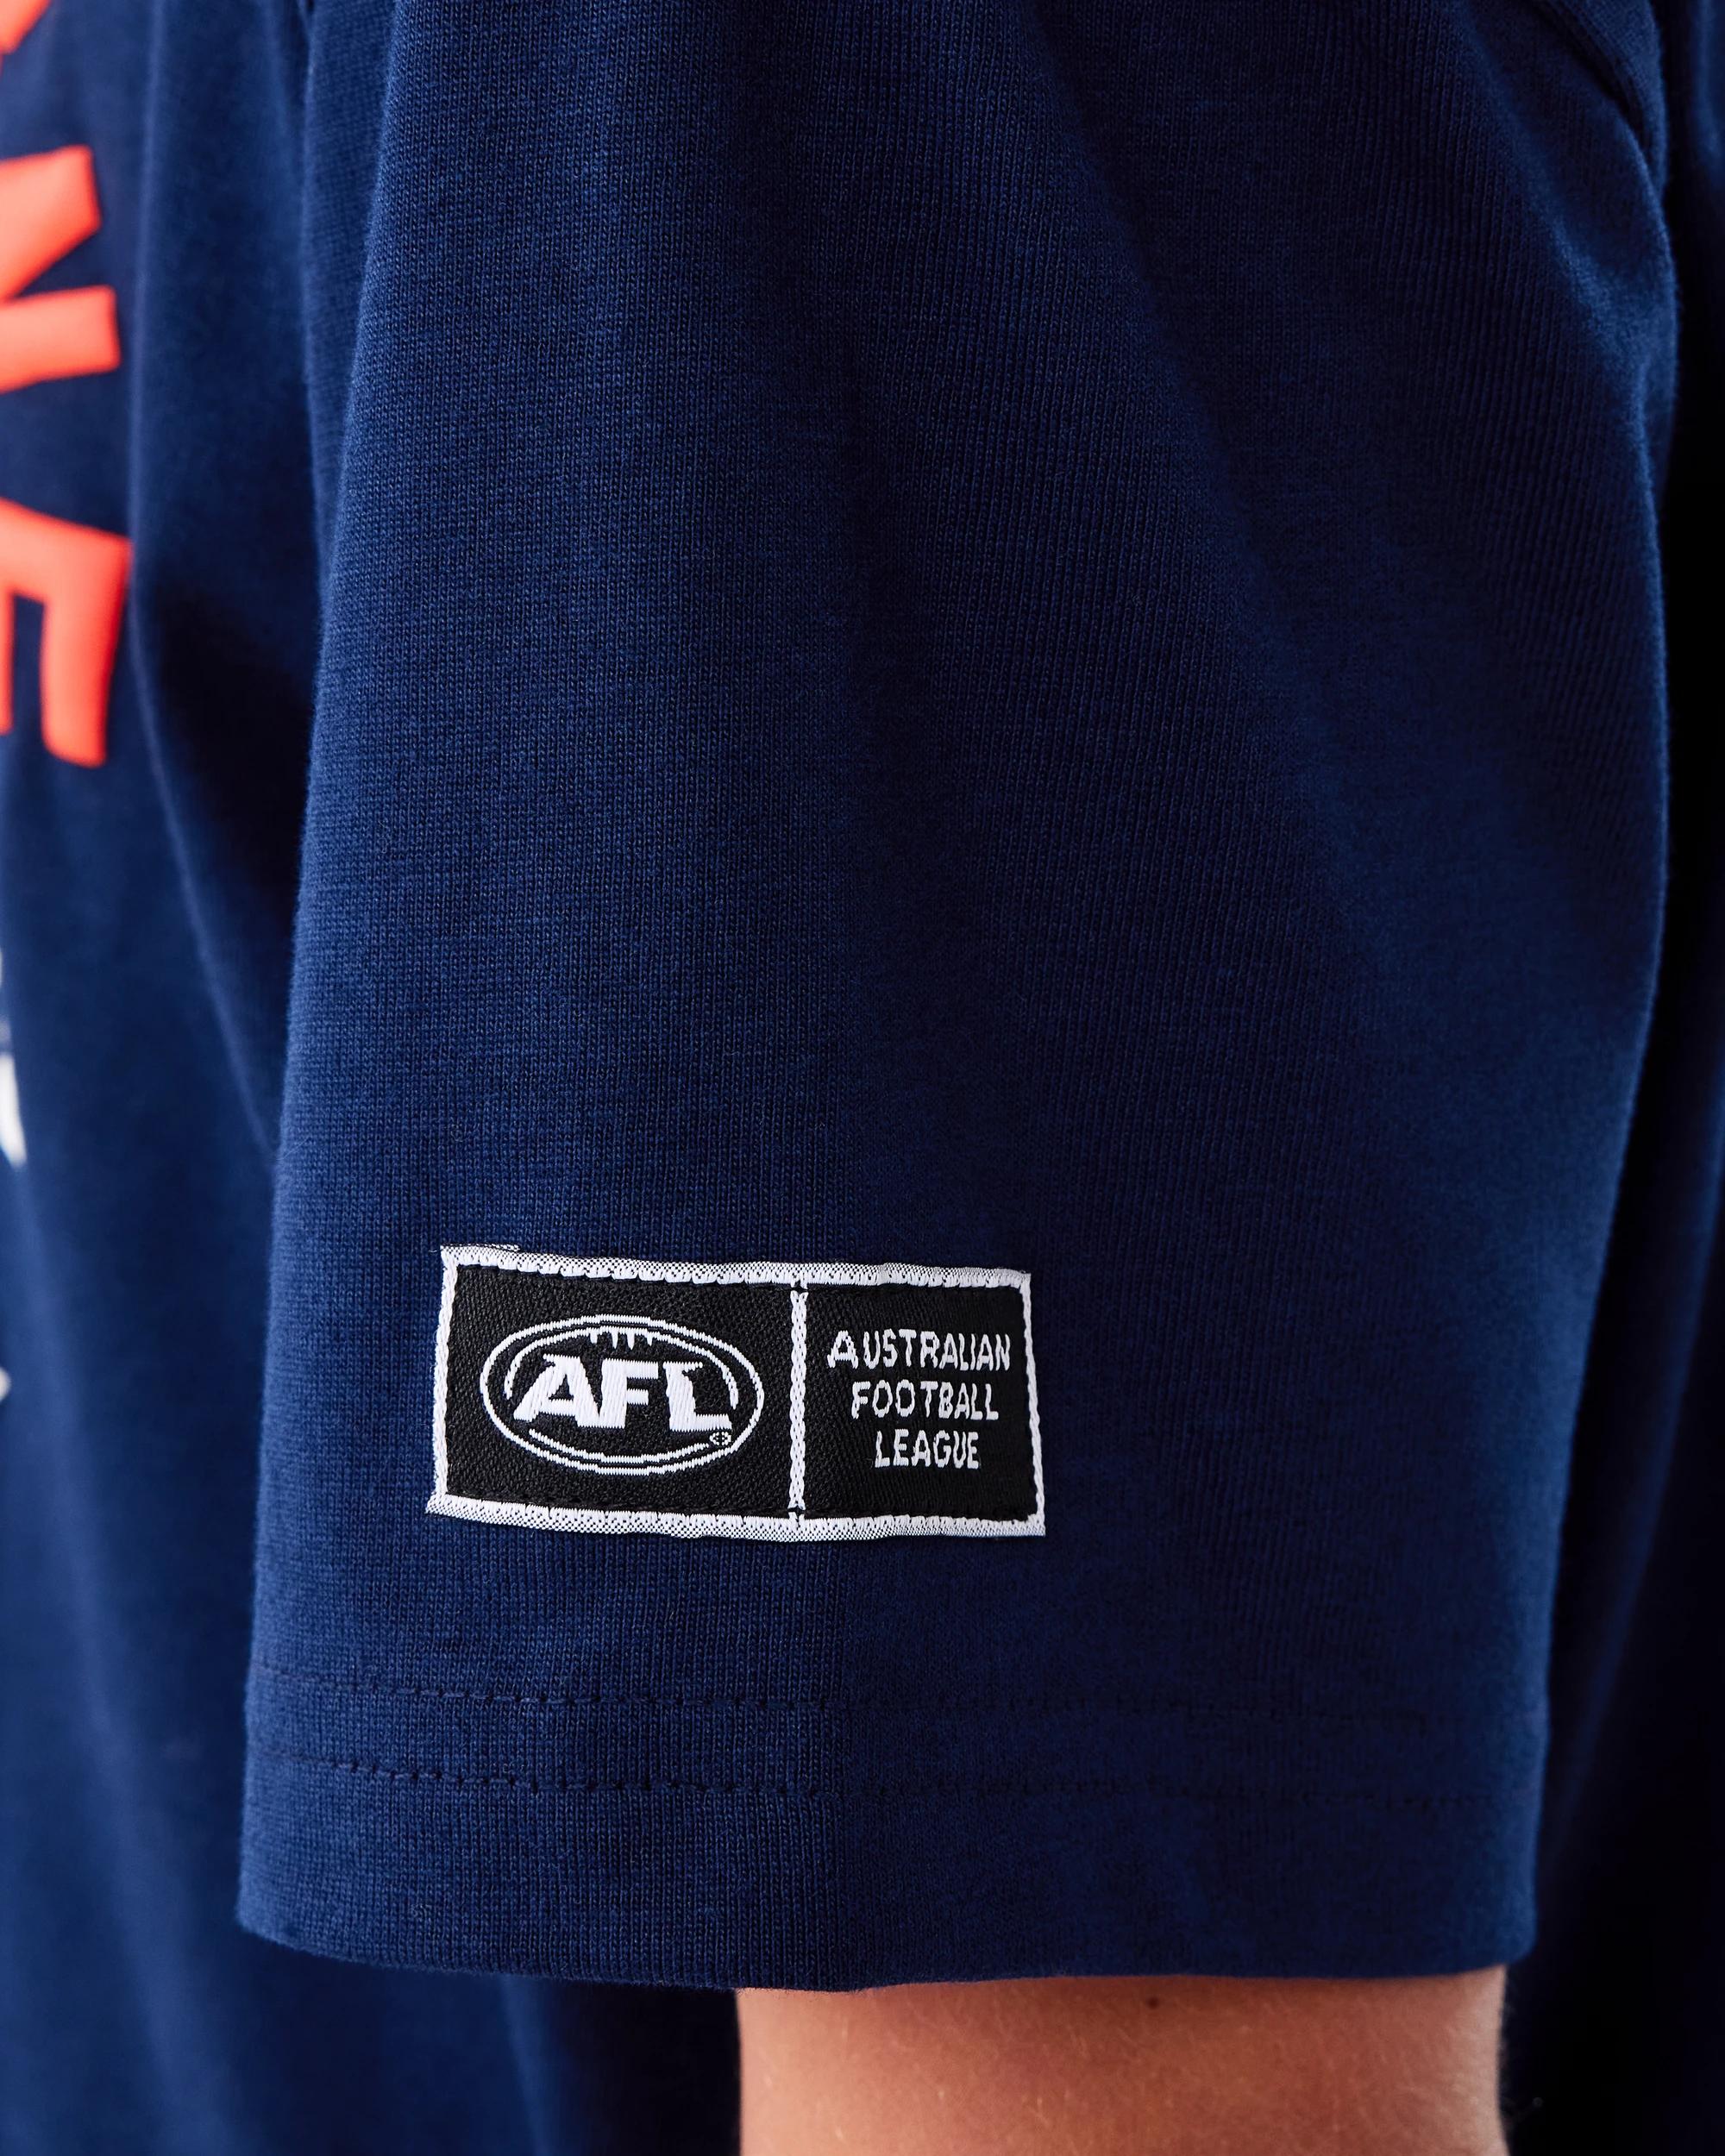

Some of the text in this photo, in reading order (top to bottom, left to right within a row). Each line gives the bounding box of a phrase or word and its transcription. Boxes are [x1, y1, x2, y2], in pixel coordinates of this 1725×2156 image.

[826, 1328, 1012, 1371] AUSTRALIAN
[513, 1354, 733, 1432] AFL
[850, 1379, 1000, 1421] FOOTBALL
[875, 1428, 980, 1470] LEAGUE
